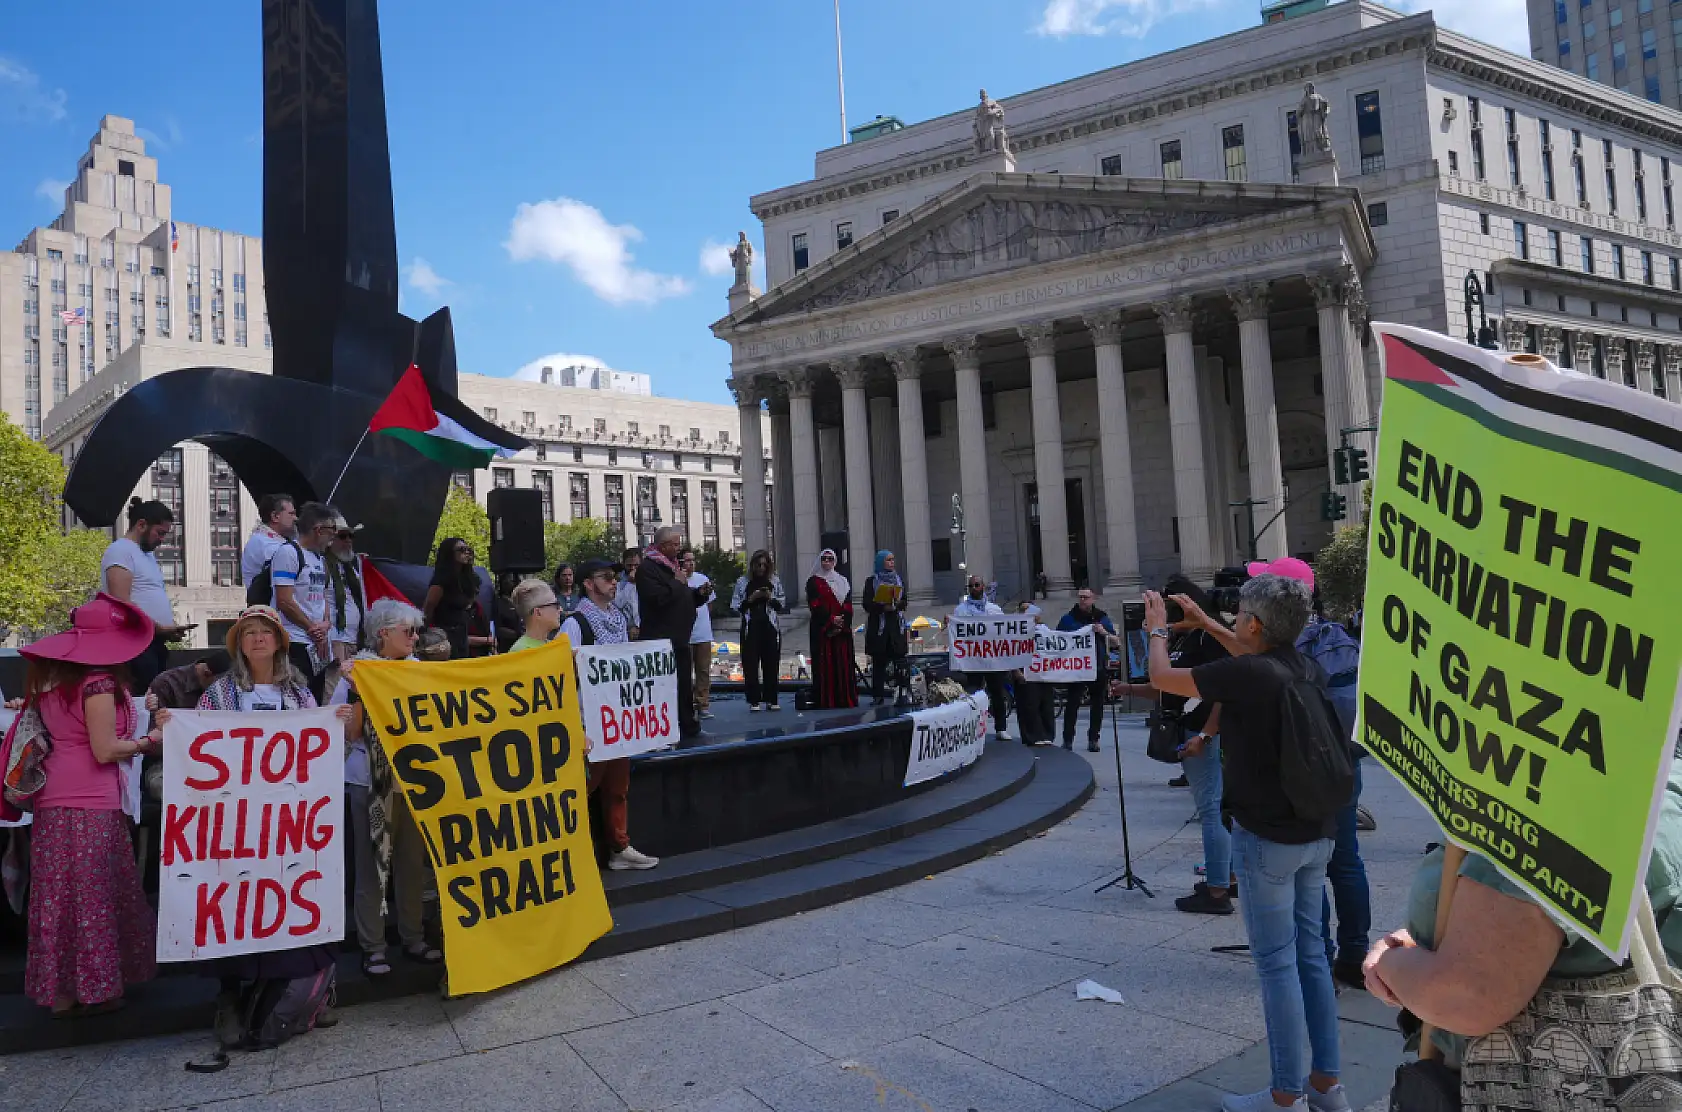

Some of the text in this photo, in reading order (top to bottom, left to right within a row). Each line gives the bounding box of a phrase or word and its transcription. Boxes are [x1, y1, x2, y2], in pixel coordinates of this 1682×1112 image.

[795, 317, 891, 346] ADMINISTRATION
[894, 313, 909, 328] OF
[915, 301, 963, 324] JUSTICE
[969, 297, 982, 313] IS
[987, 291, 1010, 310] THE
[1015, 279, 1070, 304] FIRMEST
[1076, 270, 1122, 293] PILLAR
[1127, 264, 1147, 281] OF
[1153, 255, 1199, 278] GOOD
[1206, 230, 1322, 266] GOVERNMENT
[1398, 439, 1641, 598] END THE
[956, 620, 1028, 638] END THE
[1378, 501, 1654, 701] STARVATION
[587, 650, 677, 686] SEND BREAD
[953, 637, 1035, 659] STARVATION
[1029, 653, 1093, 674] GENOCIDE
[1034, 633, 1066, 651] END
[385, 673, 566, 736] JEWS SAY
[619, 680, 655, 707] NOT
[1383, 594, 1606, 776] OF GAZA
[184, 727, 331, 791] STOP
[600, 701, 671, 745] BOMBS
[1408, 670, 1547, 804] NOW!
[393, 721, 571, 811] STOP
[1401, 724, 1539, 849] WORKERS.ORG
[162, 795, 334, 867] KILLING
[1366, 723, 1604, 919] WORKERS WORLD PARTY
[194, 870, 323, 948] KIDS
